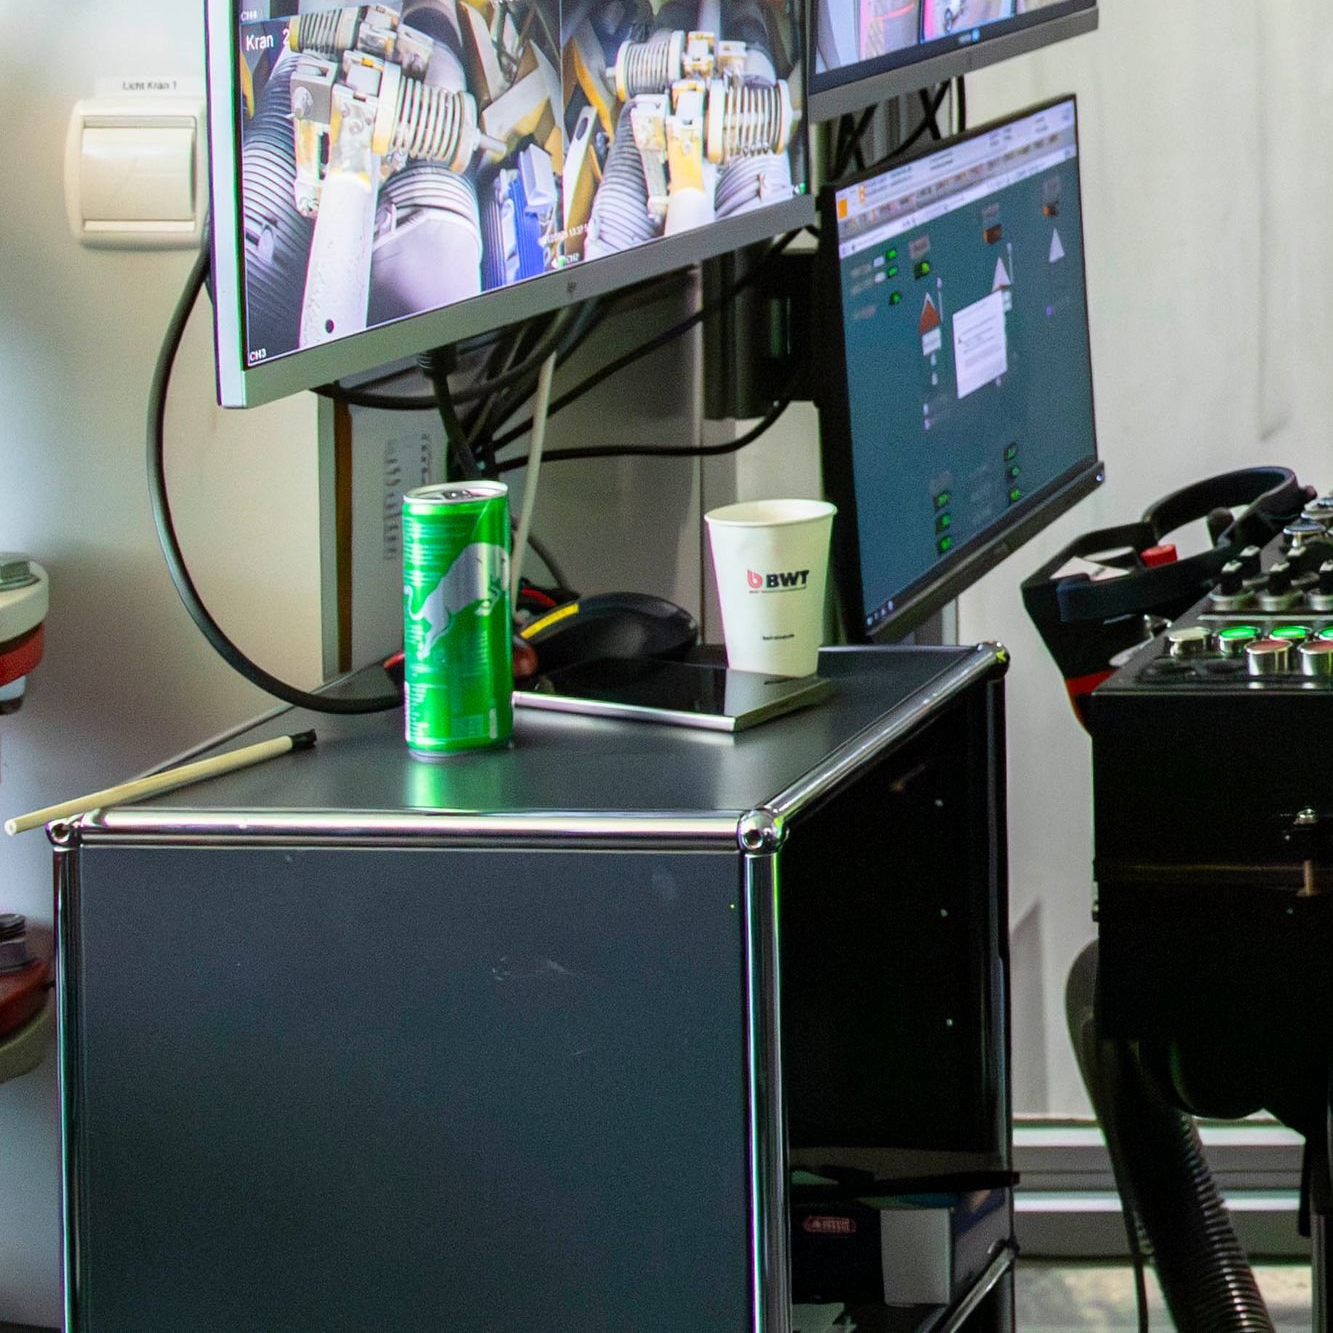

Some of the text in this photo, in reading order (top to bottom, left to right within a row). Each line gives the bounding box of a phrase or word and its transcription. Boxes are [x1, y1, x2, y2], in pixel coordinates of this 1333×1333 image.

[246, 34, 274, 52] Kran
[121, 81, 145, 91] Licht
[250, 348, 267, 362] CH3
[766, 570, 810, 588] BWT
